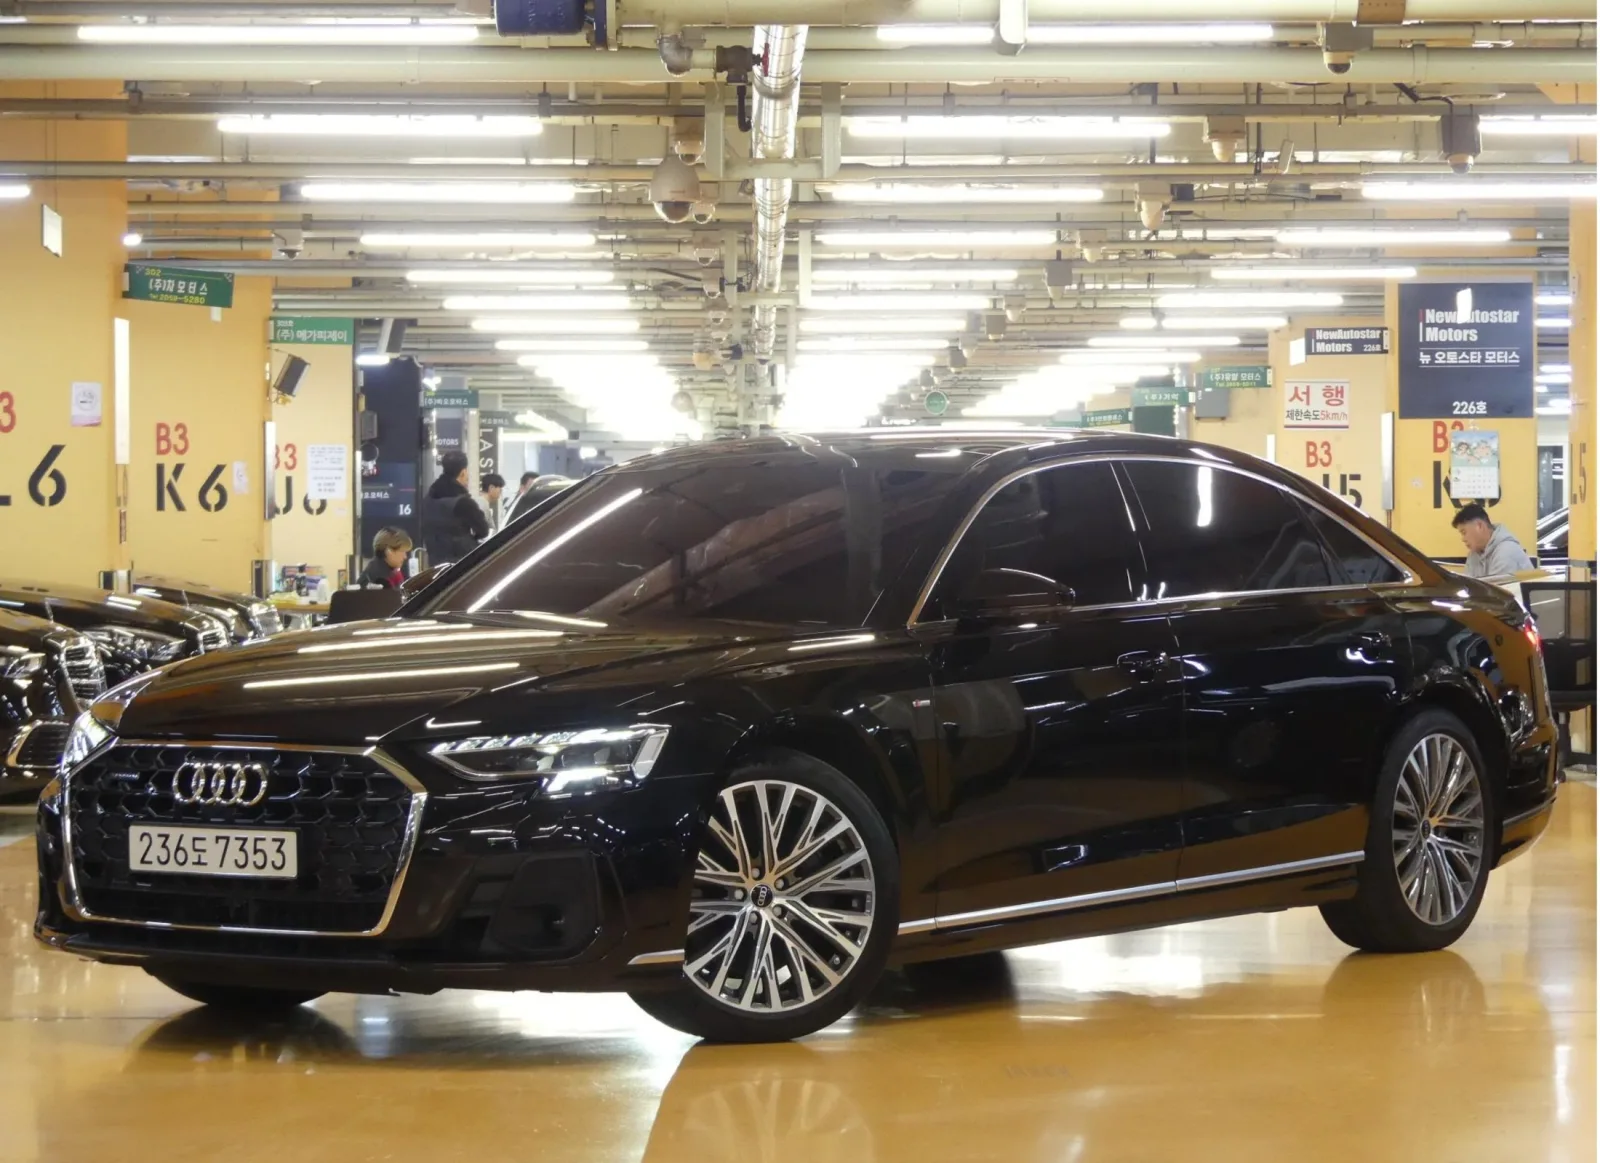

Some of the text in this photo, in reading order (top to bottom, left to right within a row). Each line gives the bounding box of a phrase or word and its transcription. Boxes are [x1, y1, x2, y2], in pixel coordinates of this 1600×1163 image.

[1315, 329, 1382, 340] NewAutostar
[1425, 326, 1478, 342] Motors
[1315, 342, 1352, 353] Motors
[1419, 351, 1520, 364] 뉴 오토스타 모터스
[1452, 400, 1487, 414] 226호
[156, 422, 190, 456] B3
[1306, 440, 1332, 468] B3
[399, 503, 412, 516] 16
[138, 832, 287, 870] 236도 7353
